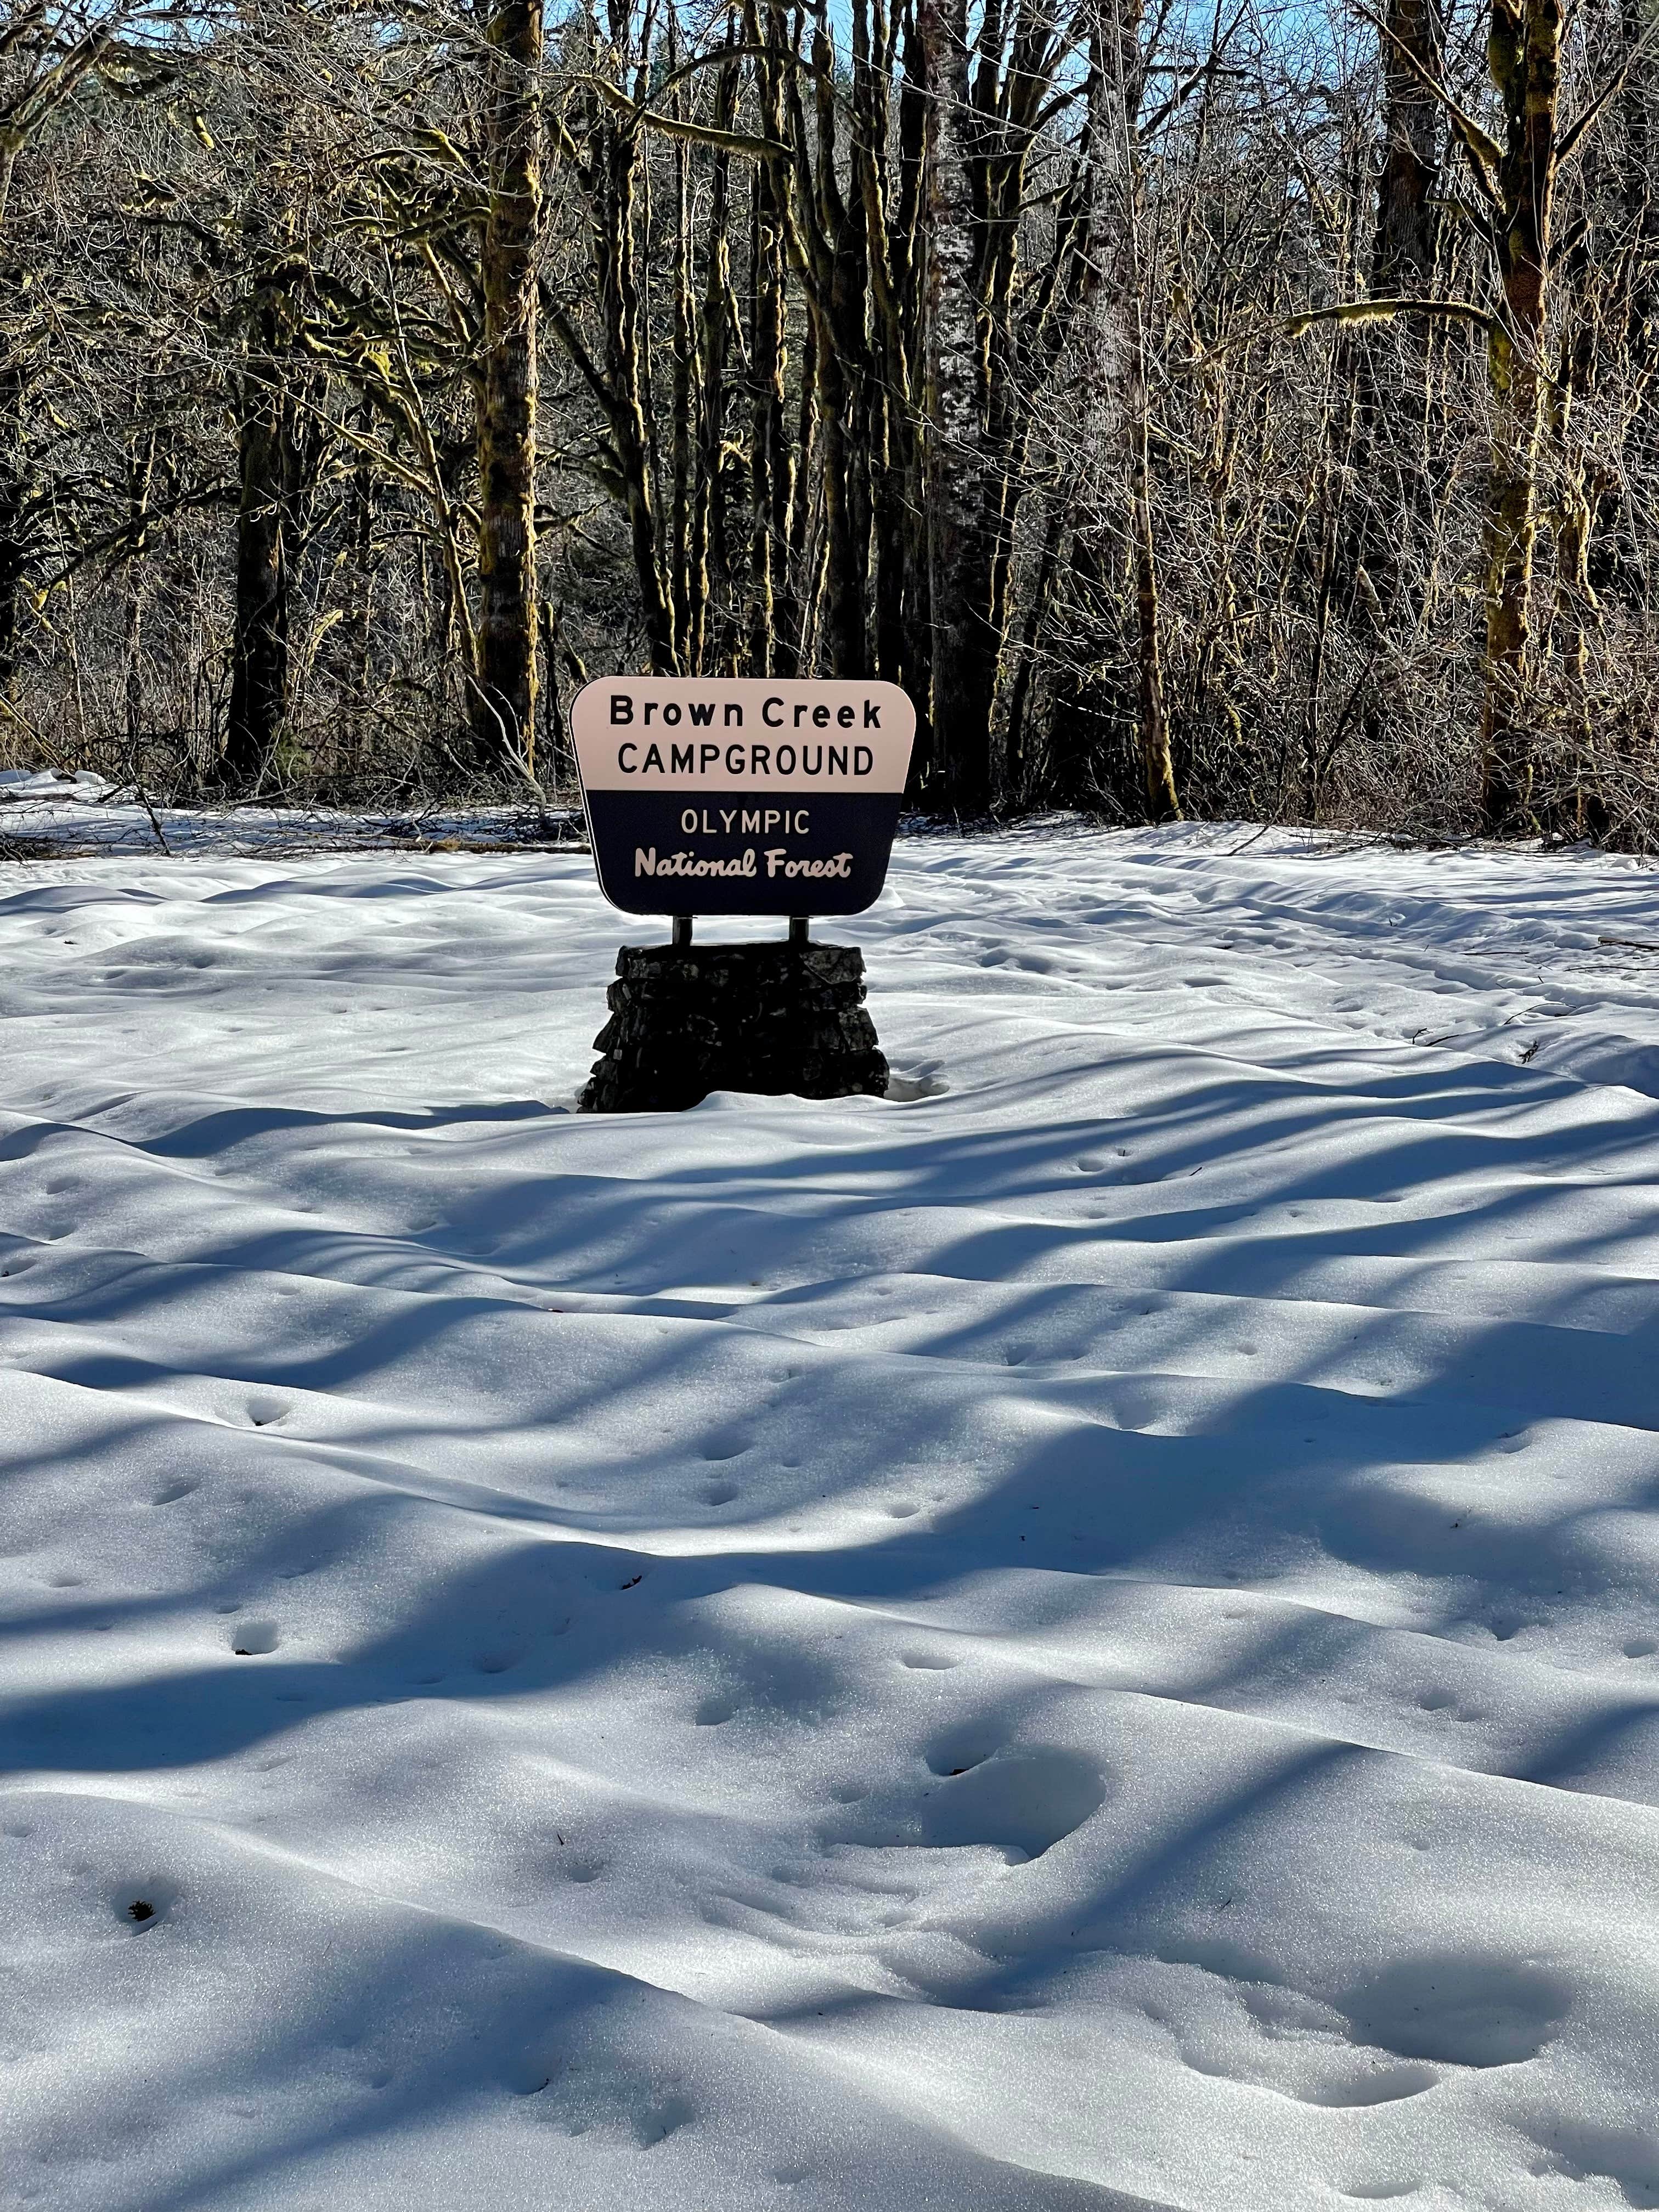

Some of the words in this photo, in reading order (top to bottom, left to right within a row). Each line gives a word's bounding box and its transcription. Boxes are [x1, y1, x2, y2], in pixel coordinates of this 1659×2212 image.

[610, 694, 743, 727] Brown
[761, 696, 882, 729] Creek
[617, 742, 874, 776] CAMPGROUND
[681, 808, 810, 834] OLYMPIC
[634, 847, 757, 878] National
[763, 848, 854, 878] Forest
